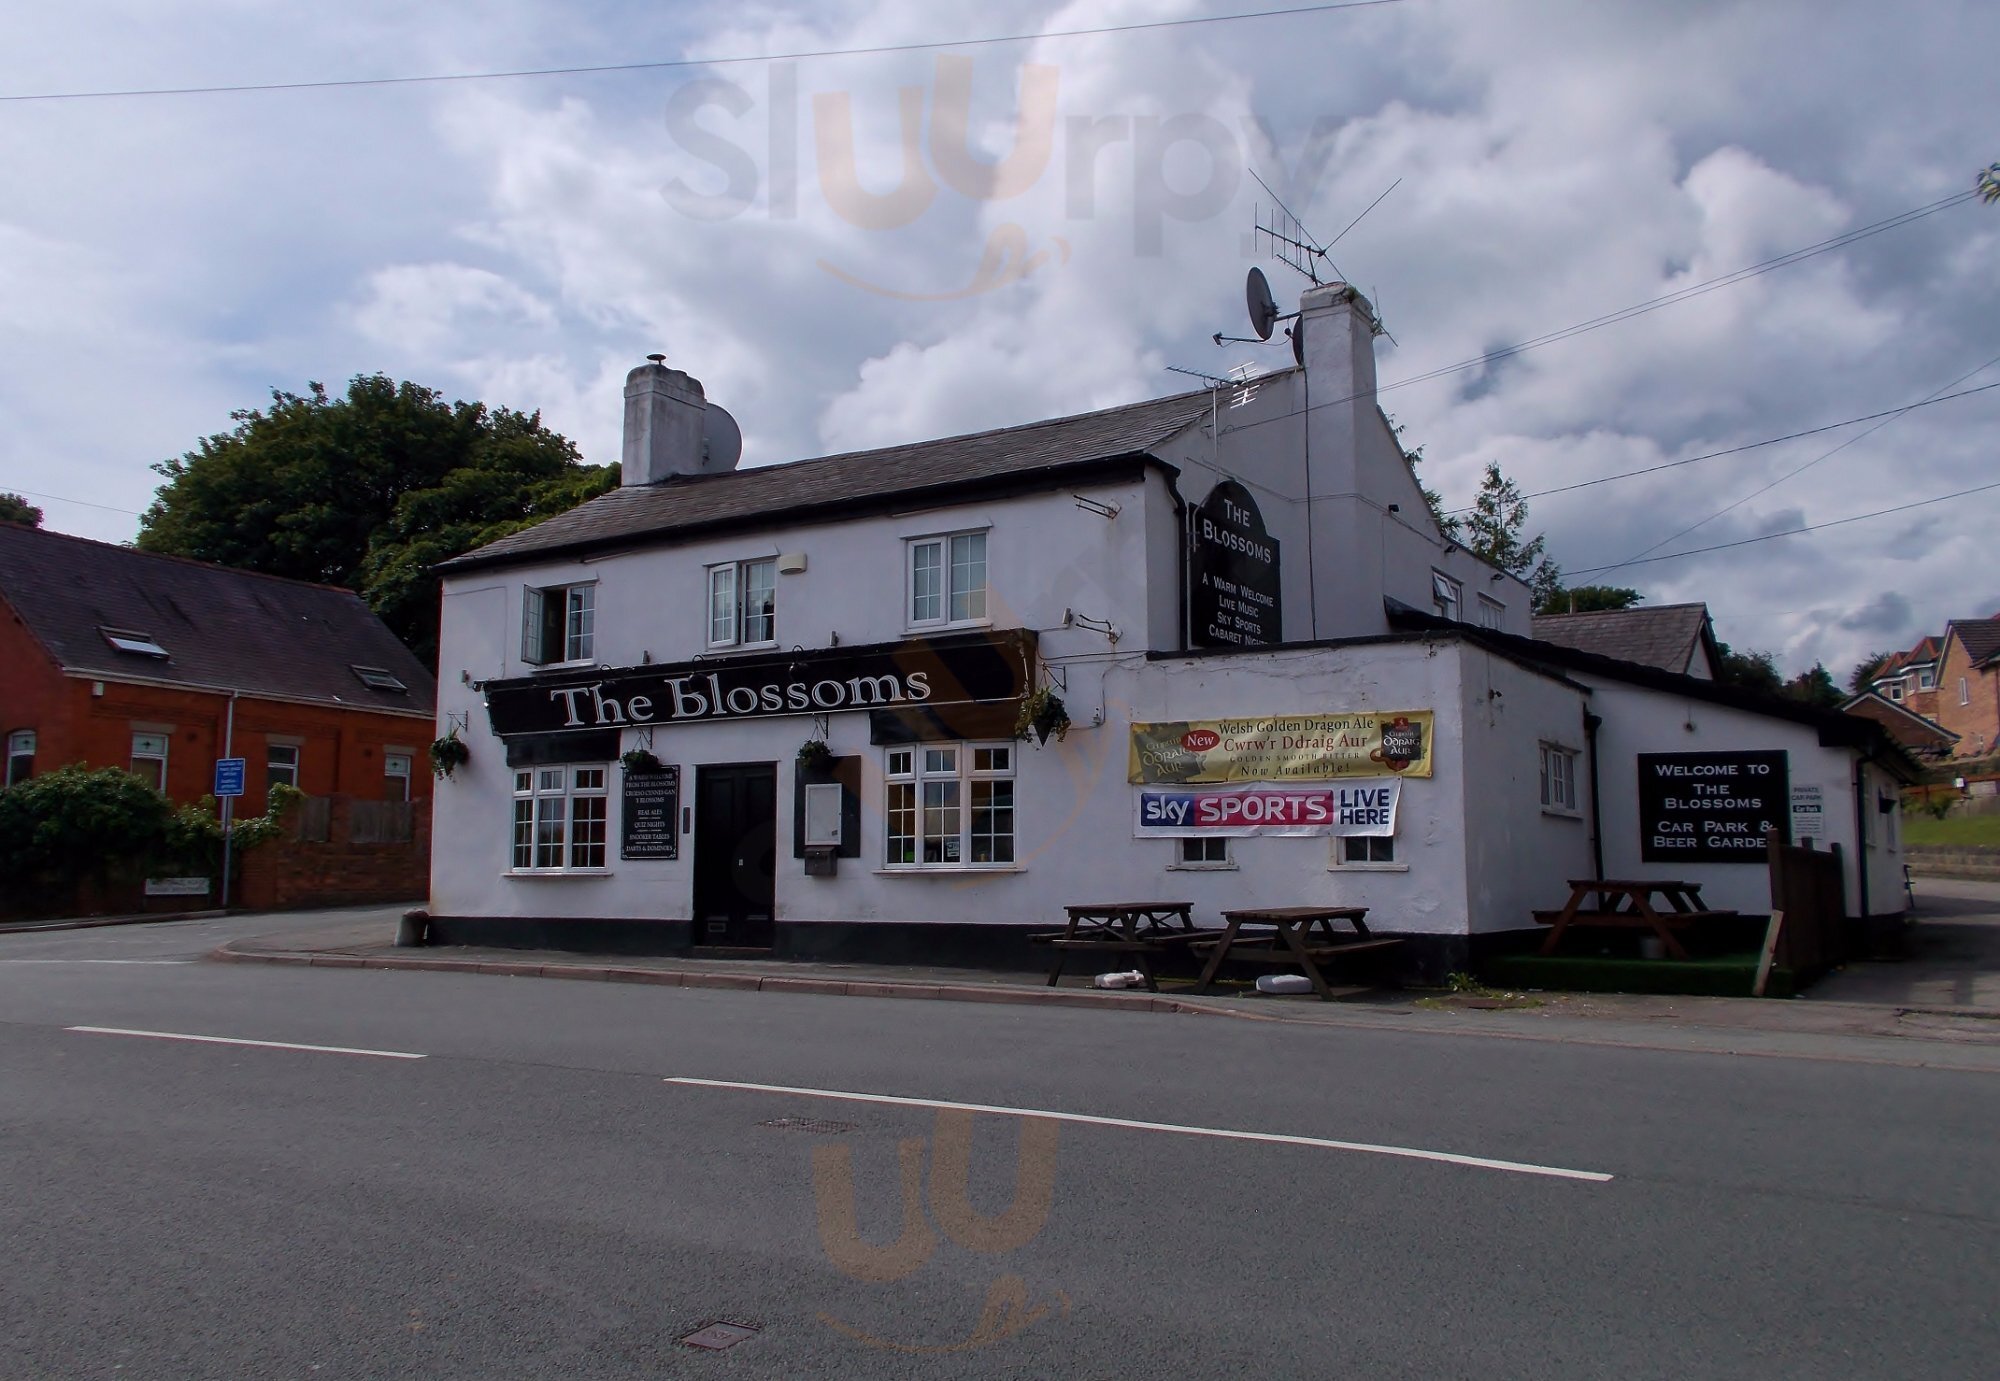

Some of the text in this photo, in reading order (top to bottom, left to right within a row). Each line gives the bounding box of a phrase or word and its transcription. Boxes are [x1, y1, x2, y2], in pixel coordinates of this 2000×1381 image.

[1224, 499, 1250, 527] THE
[1203, 519, 1272, 564] BLOSSOMS
[1202, 572, 1274, 607] A WARM WELCOME
[1219, 594, 1259, 618] LIVE MUSIC
[1217, 611, 1261, 635] SKY SPORTS
[1208, 624, 1242, 644] CABARET
[550, 671, 932, 727] The Blossoms
[1219, 717, 1374, 734] Welsh Golden Dragon Ale
[1187, 734, 1215, 747] New
[1224, 733, 1368, 752] Cwrw'r Ddraig Aur
[1230, 752, 1360, 763] GOLDEN SMOOTH BITTER
[1241, 762, 1351, 777] Now Available!
[1655, 764, 1770, 776] WELCOME TO
[1340, 788, 1390, 807] LIVE
[1693, 783, 1730, 795] THE
[1146, 795, 1327, 825] sky SPORTS
[1664, 797, 1762, 809] BLOSSOMS
[1339, 808, 1390, 825] HERE
[1657, 820, 1773, 833] CAR PARK &
[1653, 836, 1768, 848] BEER GARDE
